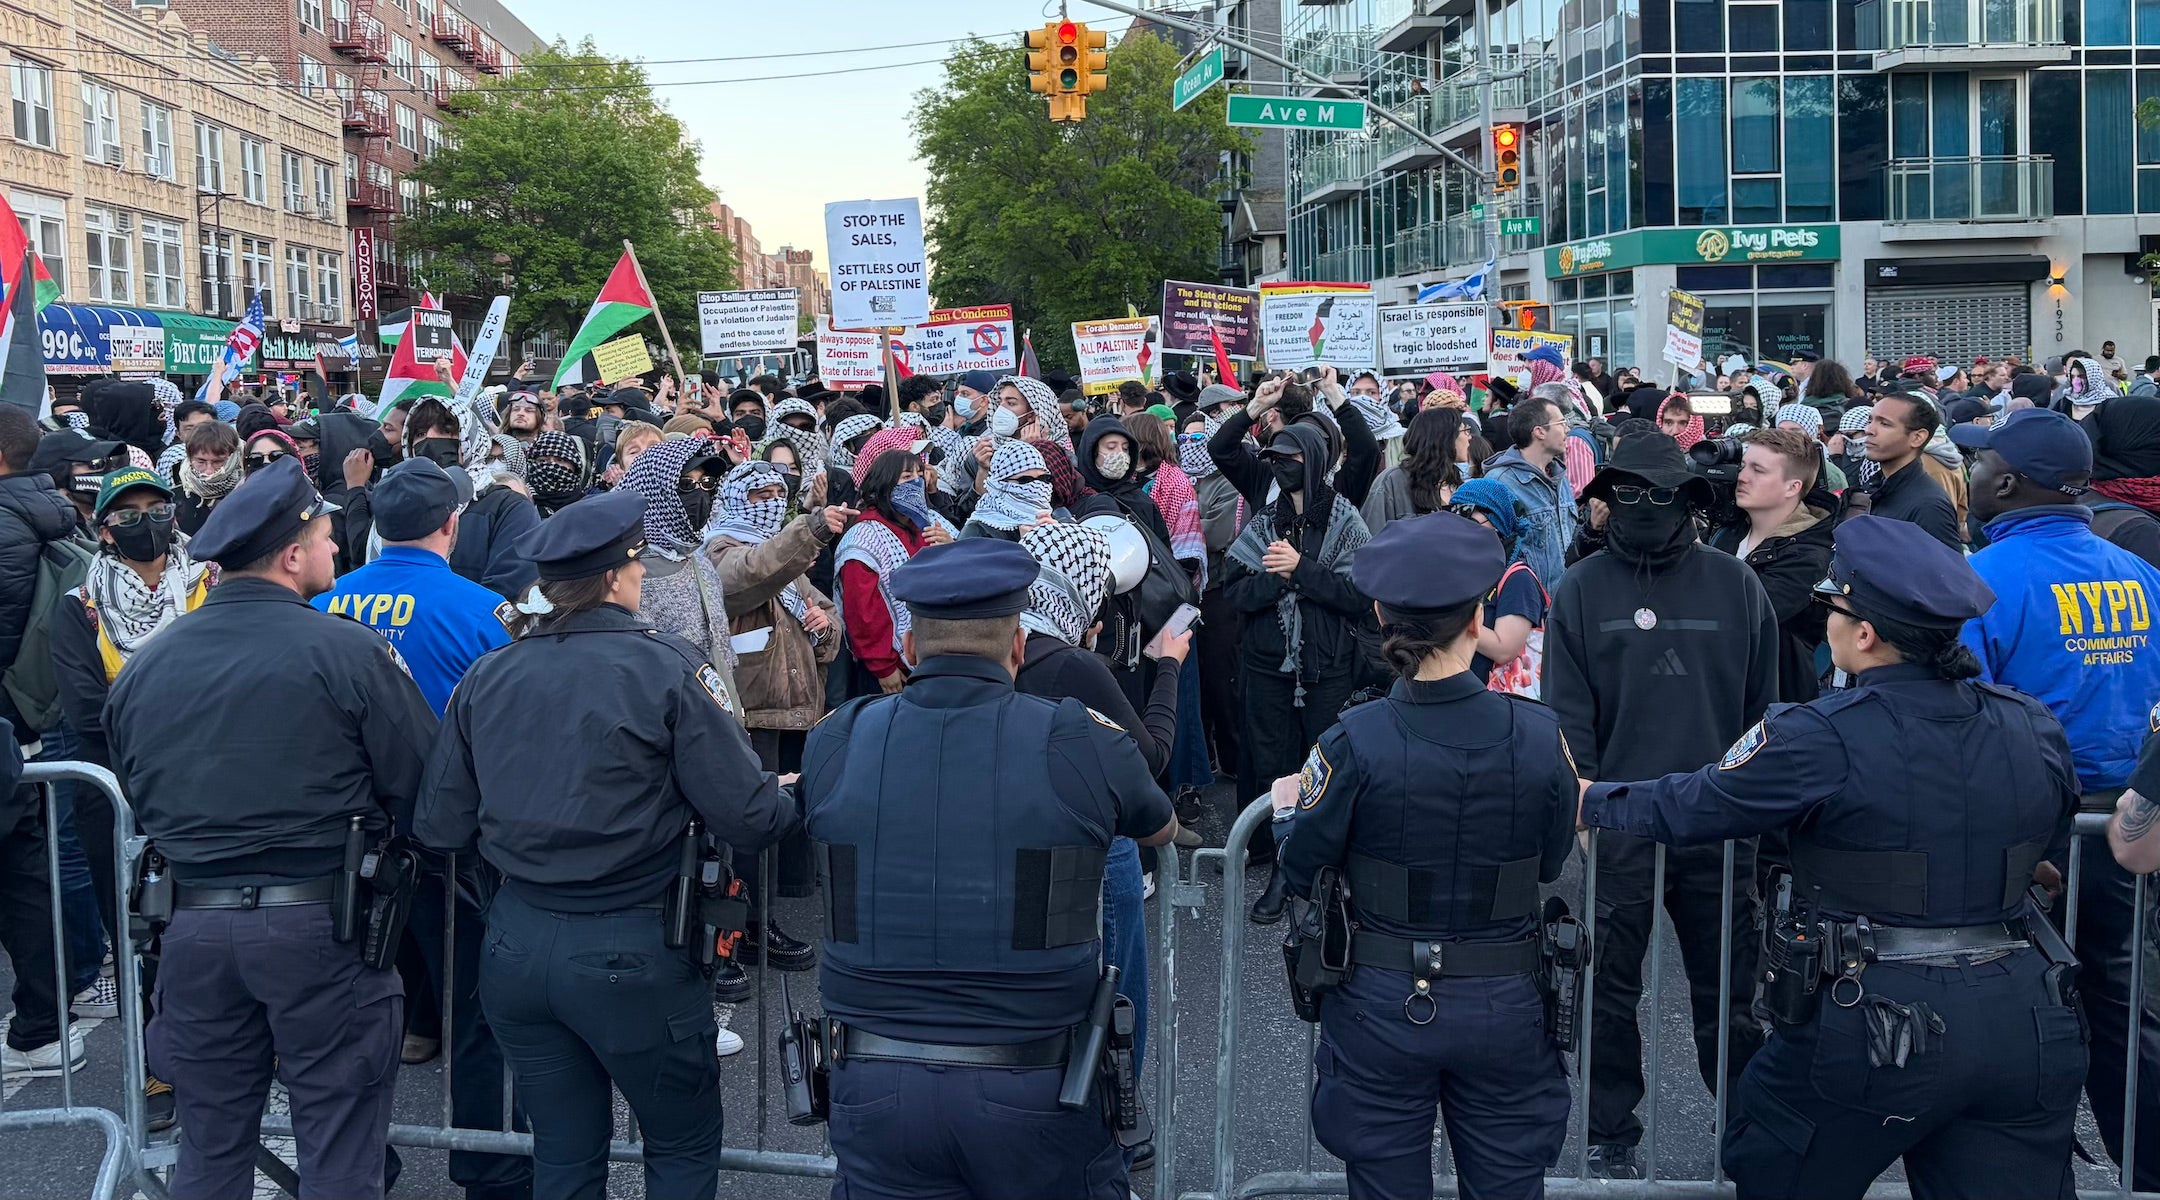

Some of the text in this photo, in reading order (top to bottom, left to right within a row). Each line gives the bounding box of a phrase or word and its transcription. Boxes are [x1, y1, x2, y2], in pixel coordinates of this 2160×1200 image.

[1183, 63, 1213, 96] Ocean Av
[1259, 102, 1335, 123] Ave M
[843, 214, 905, 228] STOP THE
[1506, 219, 1532, 233] Ave M
[852, 233, 896, 247] SALES,
[1731, 229, 1818, 251] Ivy Pets
[358, 229, 373, 318] LAUNDROMAT
[838, 262, 921, 275] SETTLERS OUT
[840, 279, 921, 291] OF PALESTINE
[700, 290, 794, 303] Stop Selling stolen land
[1178, 288, 1250, 304] The State of Israel
[703, 306, 748, 314] Occupation
[760, 304, 795, 312] Palestine
[1201, 300, 1212, 308] its
[1214, 302, 1242, 312] actions
[415, 312, 452, 328] ZIONISM
[721, 316, 754, 324] violation
[952, 308, 1009, 320] Condemns
[1237, 315, 1248, 324] but
[1276, 312, 1302, 320] FREEDOM
[1383, 306, 1484, 322] Israel is responsible
[926, 328, 944, 338] the
[1085, 322, 1144, 334] Torah Demands
[1415, 328, 1426, 336] 78
[1430, 326, 1456, 338] years
[42, 329, 97, 360] 99¢ up
[262, 333, 316, 360] Grill Baske
[720, 338, 786, 348] endless bloodshed
[820, 334, 874, 346] always opposed
[916, 338, 956, 350] State of
[1080, 339, 1138, 355] ALL PALESTINE
[1393, 338, 1478, 354] tragic bloodshed
[1495, 335, 1520, 348] State
[1523, 336, 1534, 349] of
[112, 340, 132, 358] STORE
[144, 340, 164, 358] LEASE
[174, 342, 196, 364] DRY
[826, 348, 868, 358] Zionism
[1493, 352, 1512, 361] does
[821, 366, 875, 376] State of Israel
[918, 358, 1010, 374] And its Atrocities
[328, 594, 416, 626] NYPD
[2050, 580, 2150, 635] NYPD
[2065, 635, 2148, 652] COMMUNITY
[2084, 650, 2134, 665] AFFAIRS
